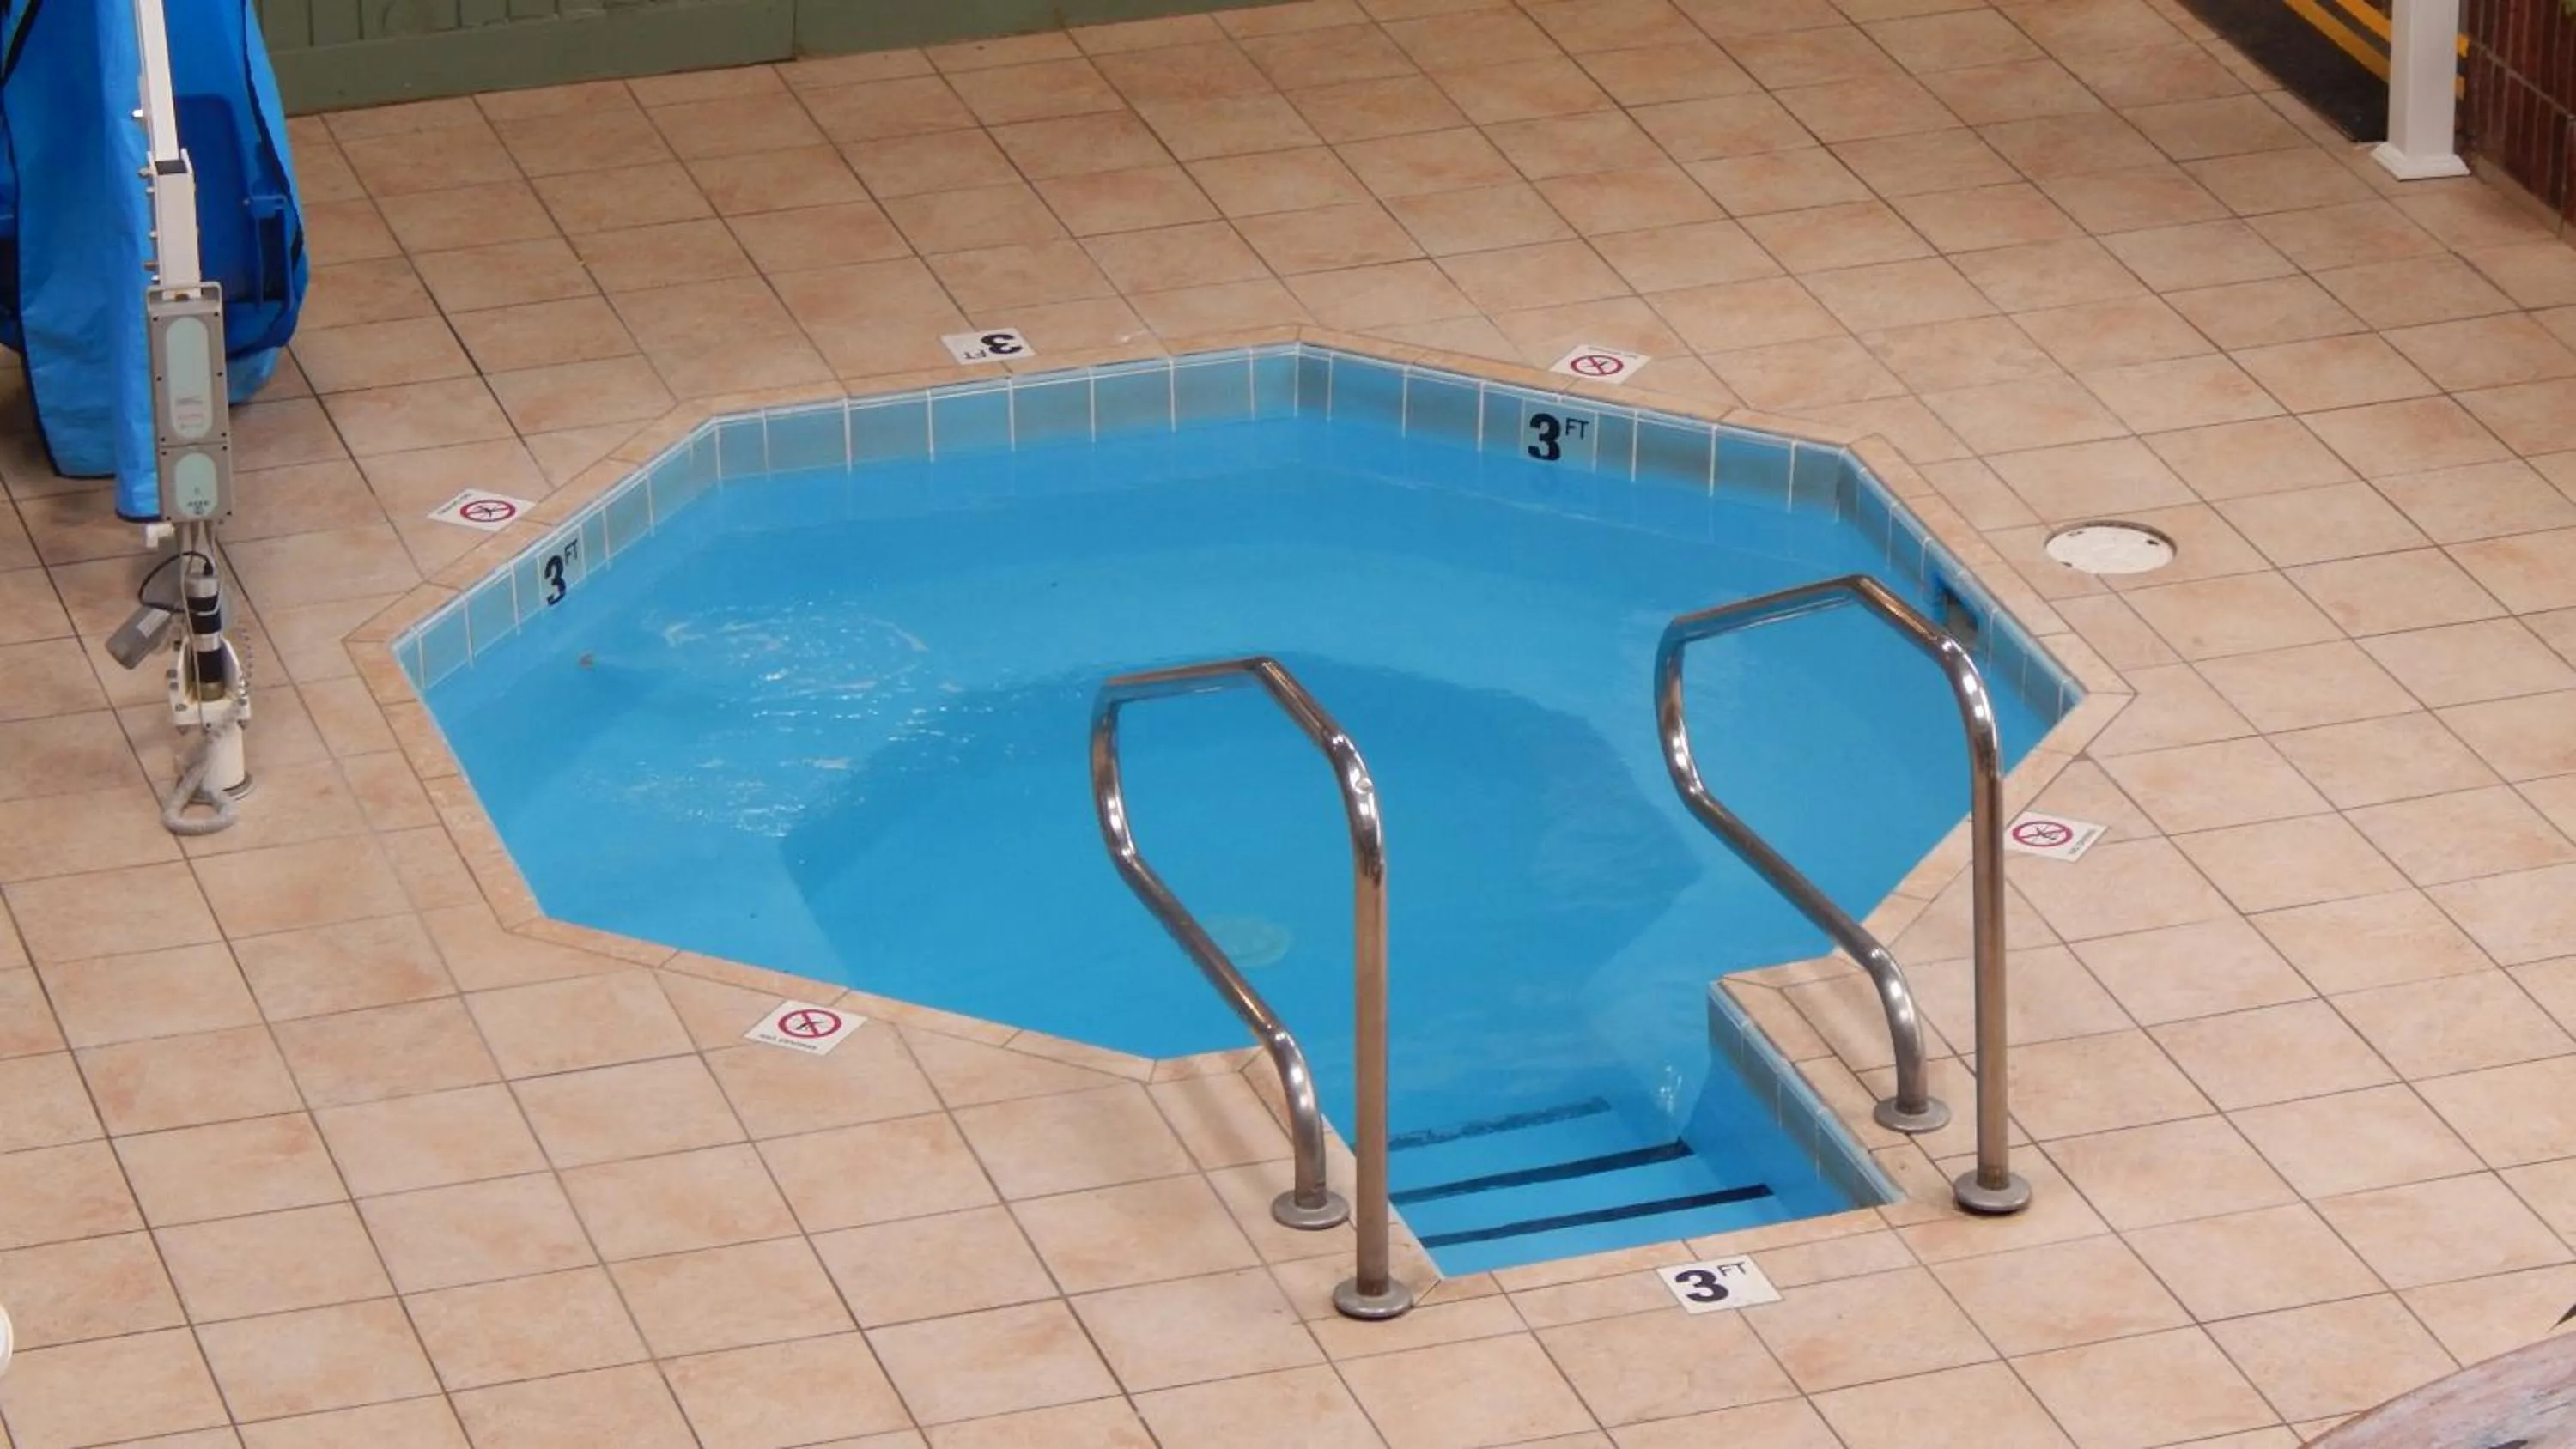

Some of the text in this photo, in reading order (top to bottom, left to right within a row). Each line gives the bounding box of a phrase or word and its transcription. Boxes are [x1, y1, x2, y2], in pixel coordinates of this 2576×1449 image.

[963, 334, 1023, 360] 3 FT
[1528, 413, 1590, 461] 3 FT
[544, 538, 578, 606] 3 FT
[1675, 1261, 1747, 1303] 3 FT
